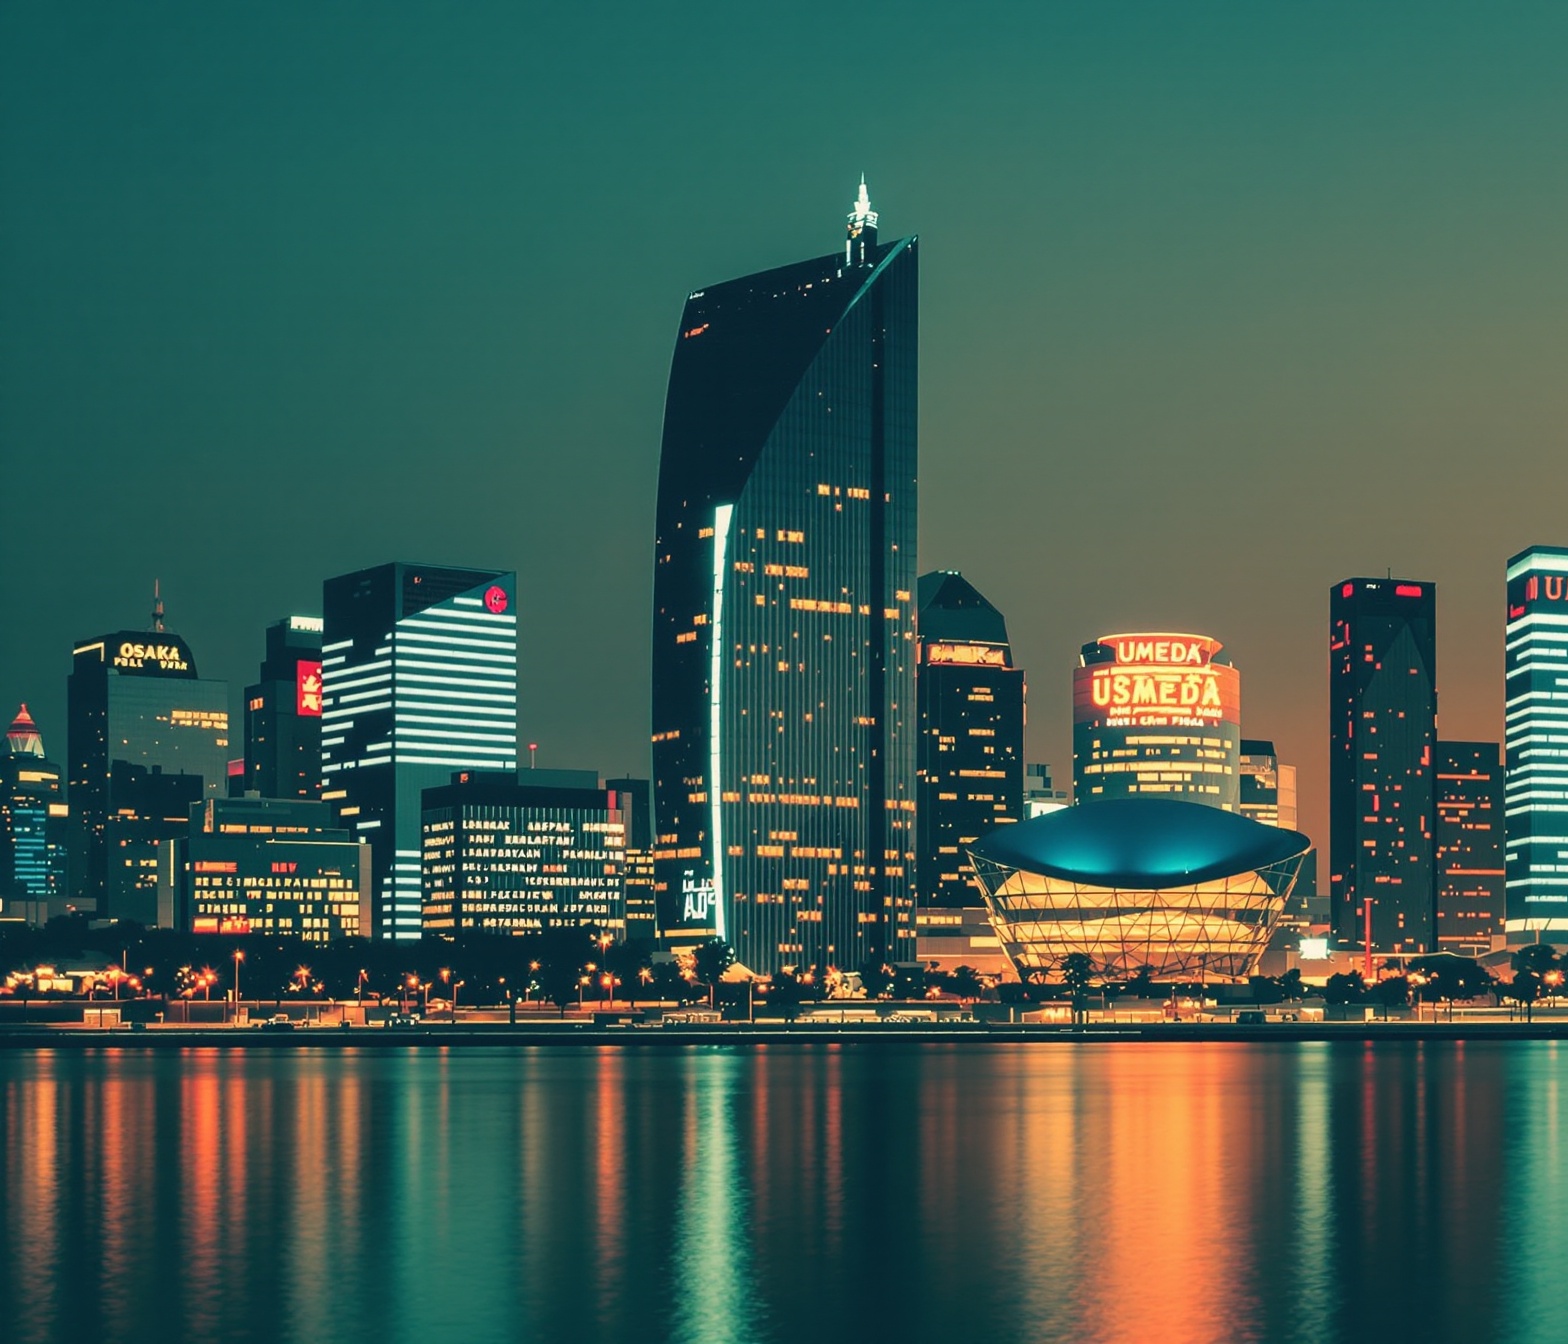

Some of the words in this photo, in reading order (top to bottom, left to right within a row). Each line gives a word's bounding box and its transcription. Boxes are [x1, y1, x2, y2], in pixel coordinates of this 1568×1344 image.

[120, 642, 180, 661] OSAKA
[1118, 641, 1202, 664] UMEDA
[1093, 674, 1222, 706] USMEDA
